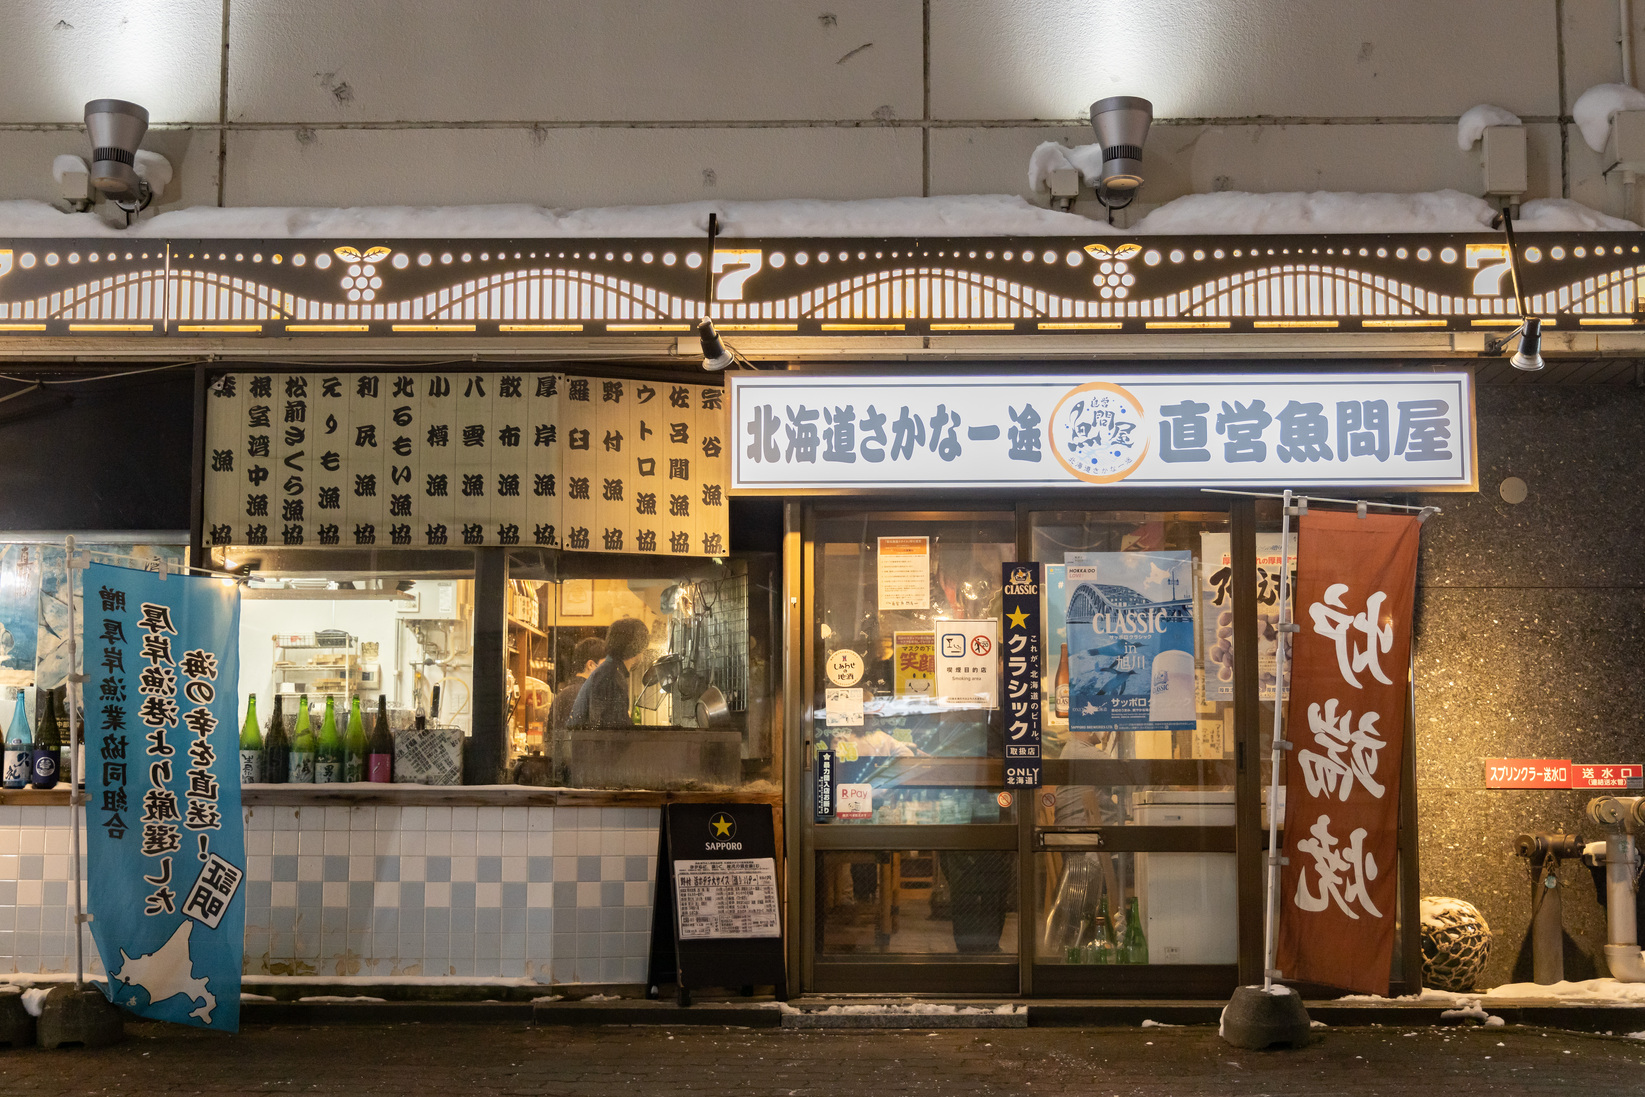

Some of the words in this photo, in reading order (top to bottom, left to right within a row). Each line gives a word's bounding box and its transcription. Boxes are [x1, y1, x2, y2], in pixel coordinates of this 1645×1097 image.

[246, 376, 272, 545] 根室湾中漁協
[281, 376, 307, 545] 松前さくら漁協
[353, 375, 379, 545] 利尻漁協
[389, 376, 414, 545] 北るもい漁協
[425, 376, 450, 545] 小樽漁協
[461, 376, 486, 545] 八雲漁協
[497, 375, 522, 545] 散布漁協
[533, 375, 558, 545] 厚岸漁協
[568, 379, 590, 549] 羅臼漁協
[602, 381, 623, 550] 野付漁協
[636, 384, 657, 552] ウトロ漁協
[669, 386, 690, 553] 佐呂間漁協
[701, 388, 722, 554] 宗谷漁協
[747, 403, 1043, 464] 北海道さかな一途
[1158, 400, 1453, 463] 直営魚問屋
[1004, 584, 1038, 595] CLASSIC
[1092, 608, 1168, 634] CLASSIC
[1116, 655, 1145, 670] 旭川
[1124, 642, 1137, 653] in
[1008, 634, 1028, 740] クラシック
[705, 842, 743, 851] SAPPORO
[850, 788, 868, 799] Pay
[1490, 765, 1567, 782] スプリンクラー送水口
[1582, 768, 1633, 779] 送水口
